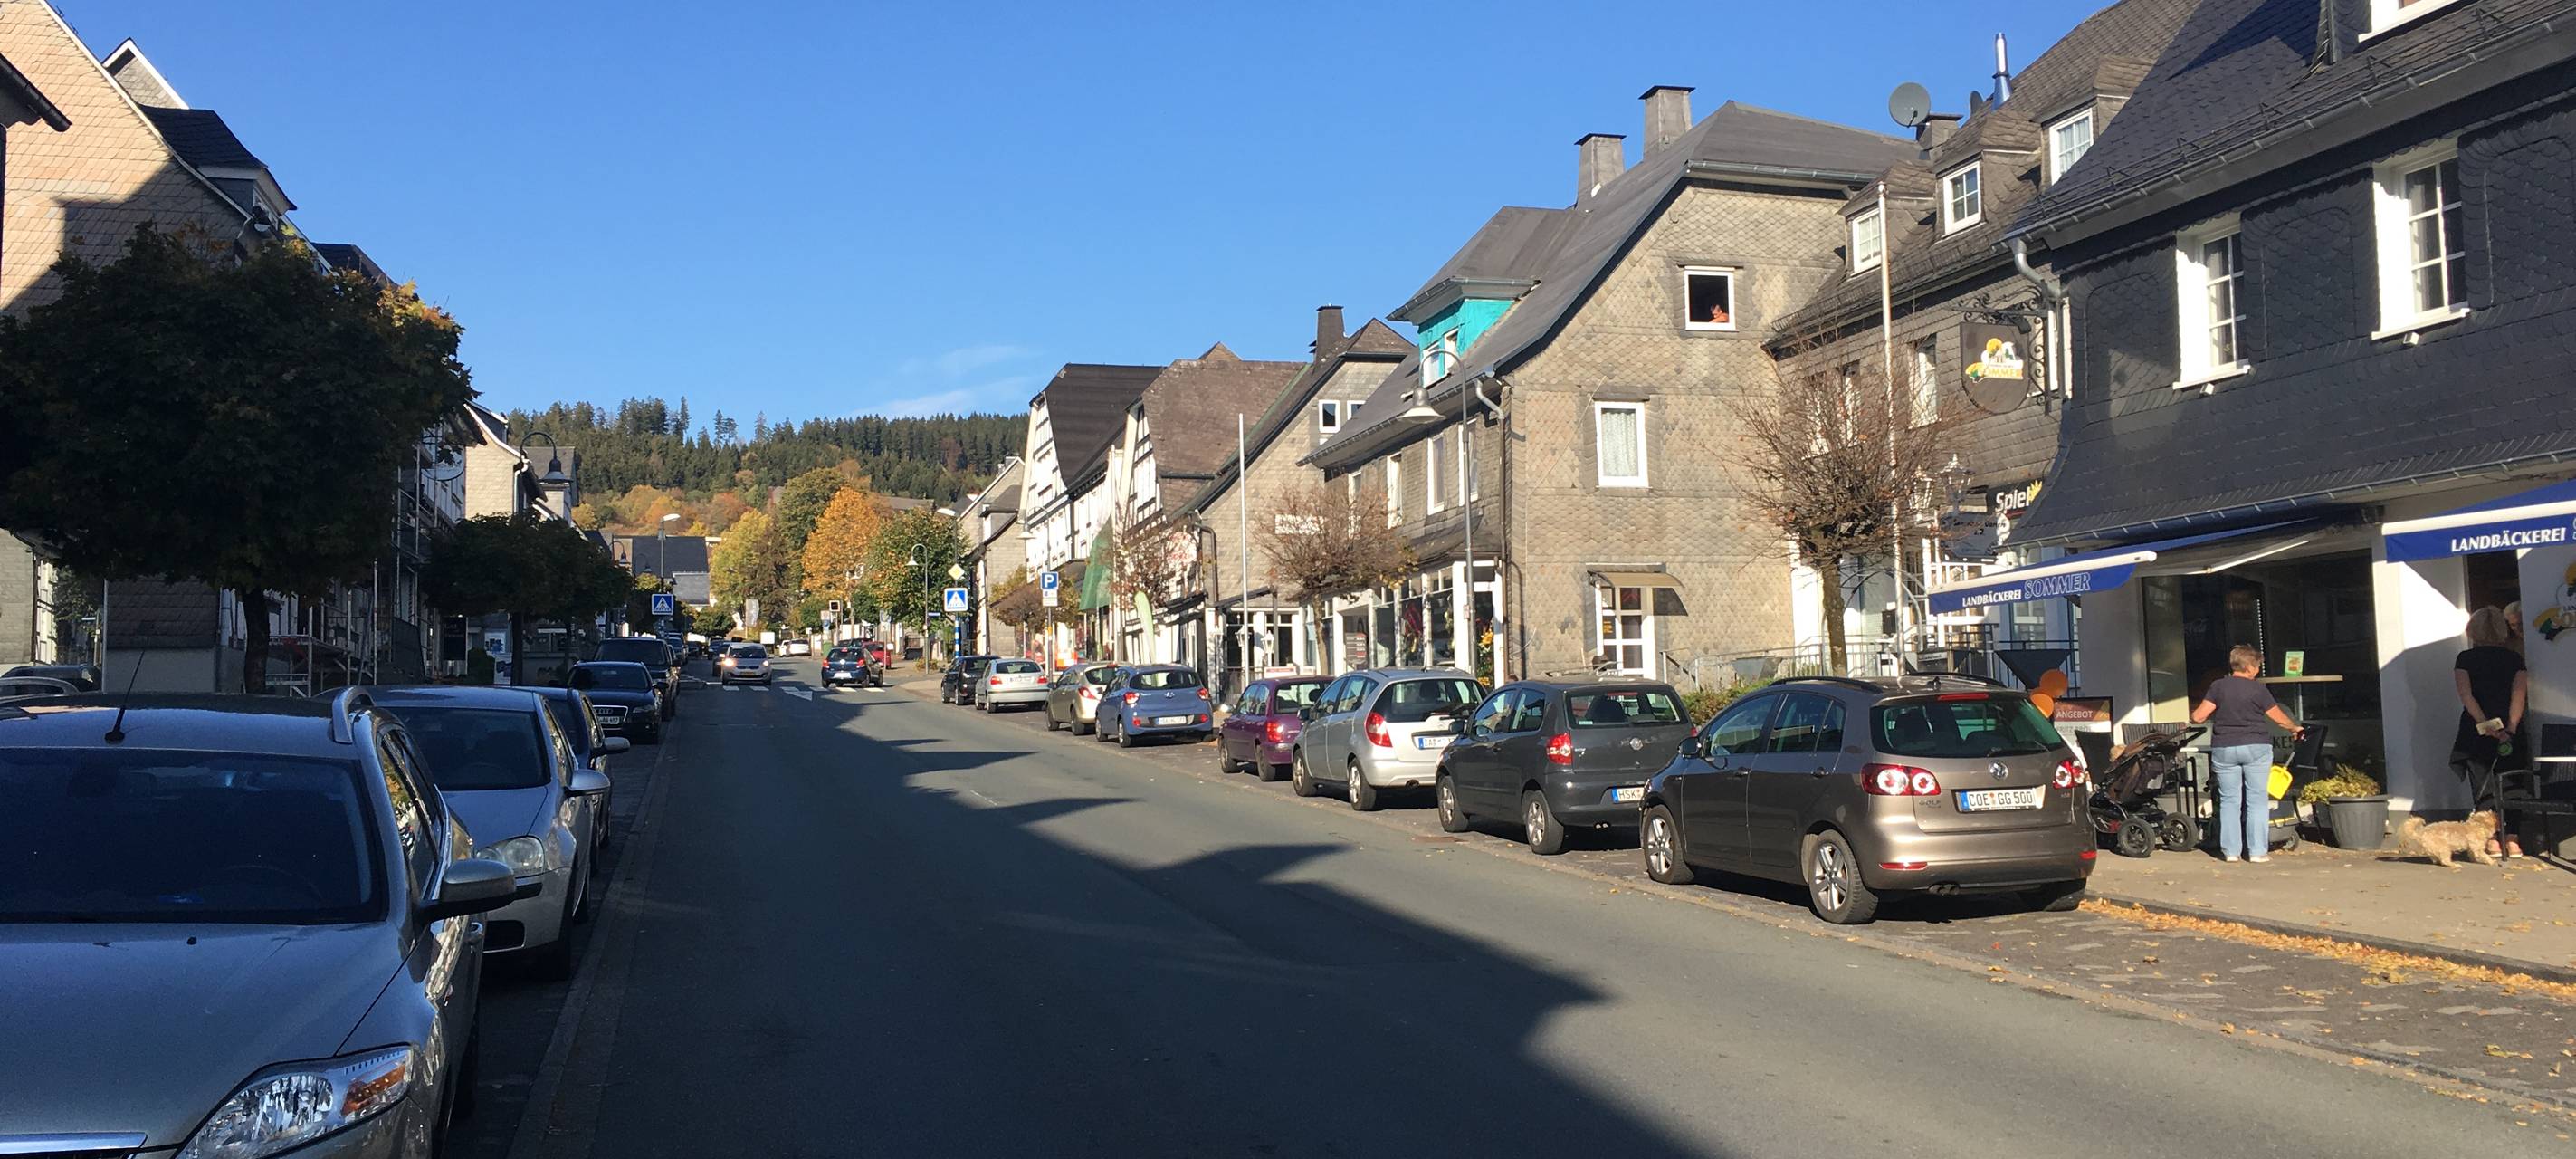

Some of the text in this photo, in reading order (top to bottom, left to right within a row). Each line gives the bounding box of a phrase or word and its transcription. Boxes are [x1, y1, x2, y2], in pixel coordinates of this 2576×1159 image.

[1995, 486, 2030, 514] Spiel
[2450, 527, 2566, 552] LANDBÄCKEREI
[1045, 574, 1054, 588] P
[1962, 572, 2091, 608] LANDBÄCKEREI SOMMER
[2056, 710, 2093, 719] ANGEBOT
[1618, 789, 1636, 800] HSK
[1969, 790, 2033, 807] COE GG 500
